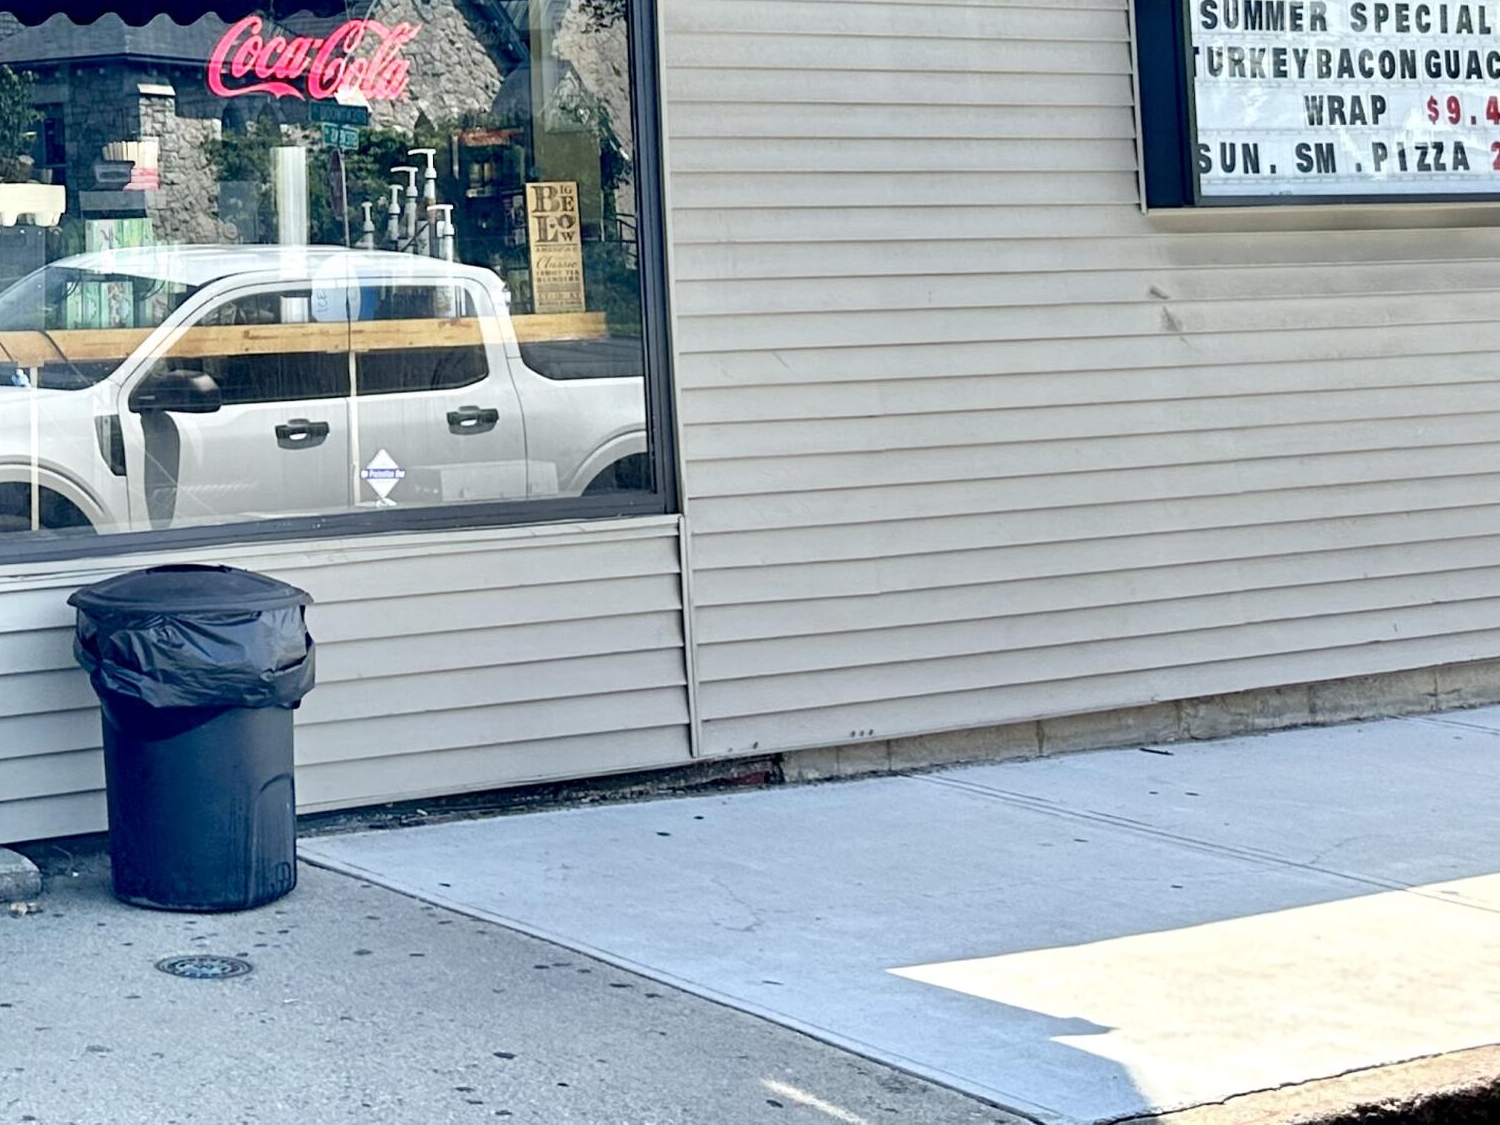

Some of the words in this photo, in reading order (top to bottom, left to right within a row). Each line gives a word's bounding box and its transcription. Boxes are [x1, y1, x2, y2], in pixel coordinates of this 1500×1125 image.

[1200, 0, 1328, 33] SUMMER
[1350, 2, 1492, 35] SPECIAL
[206, 14, 423, 100] Coca-Cola
[1304, 93, 1387, 126] WRAP
[1197, 141, 1277, 175] SUN.
